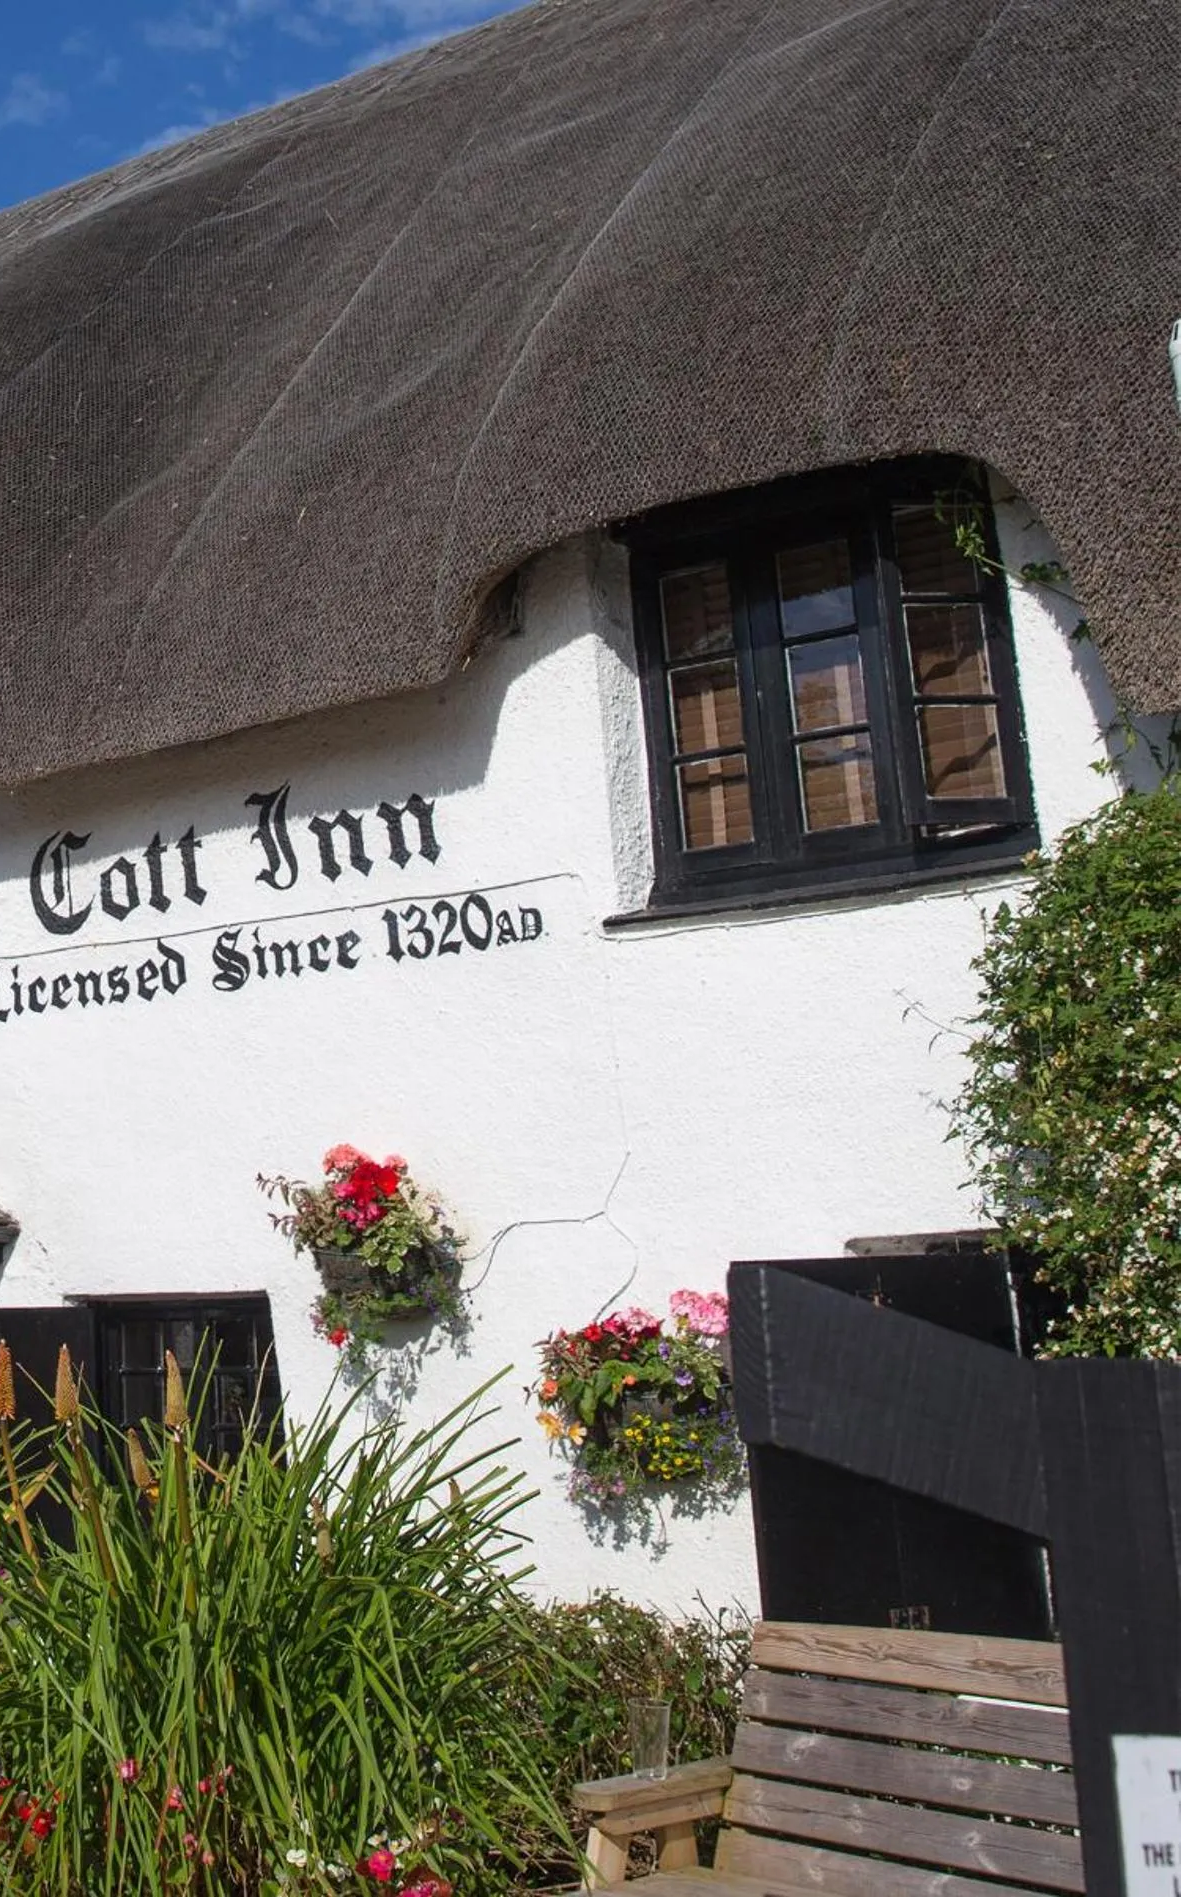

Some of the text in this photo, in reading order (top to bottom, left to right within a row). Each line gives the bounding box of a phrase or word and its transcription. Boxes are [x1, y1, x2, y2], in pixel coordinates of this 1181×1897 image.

[29, 780, 442, 936] Cott Inn
[211, 926, 361, 992] Since
[1141, 1842, 1175, 1869] THE
